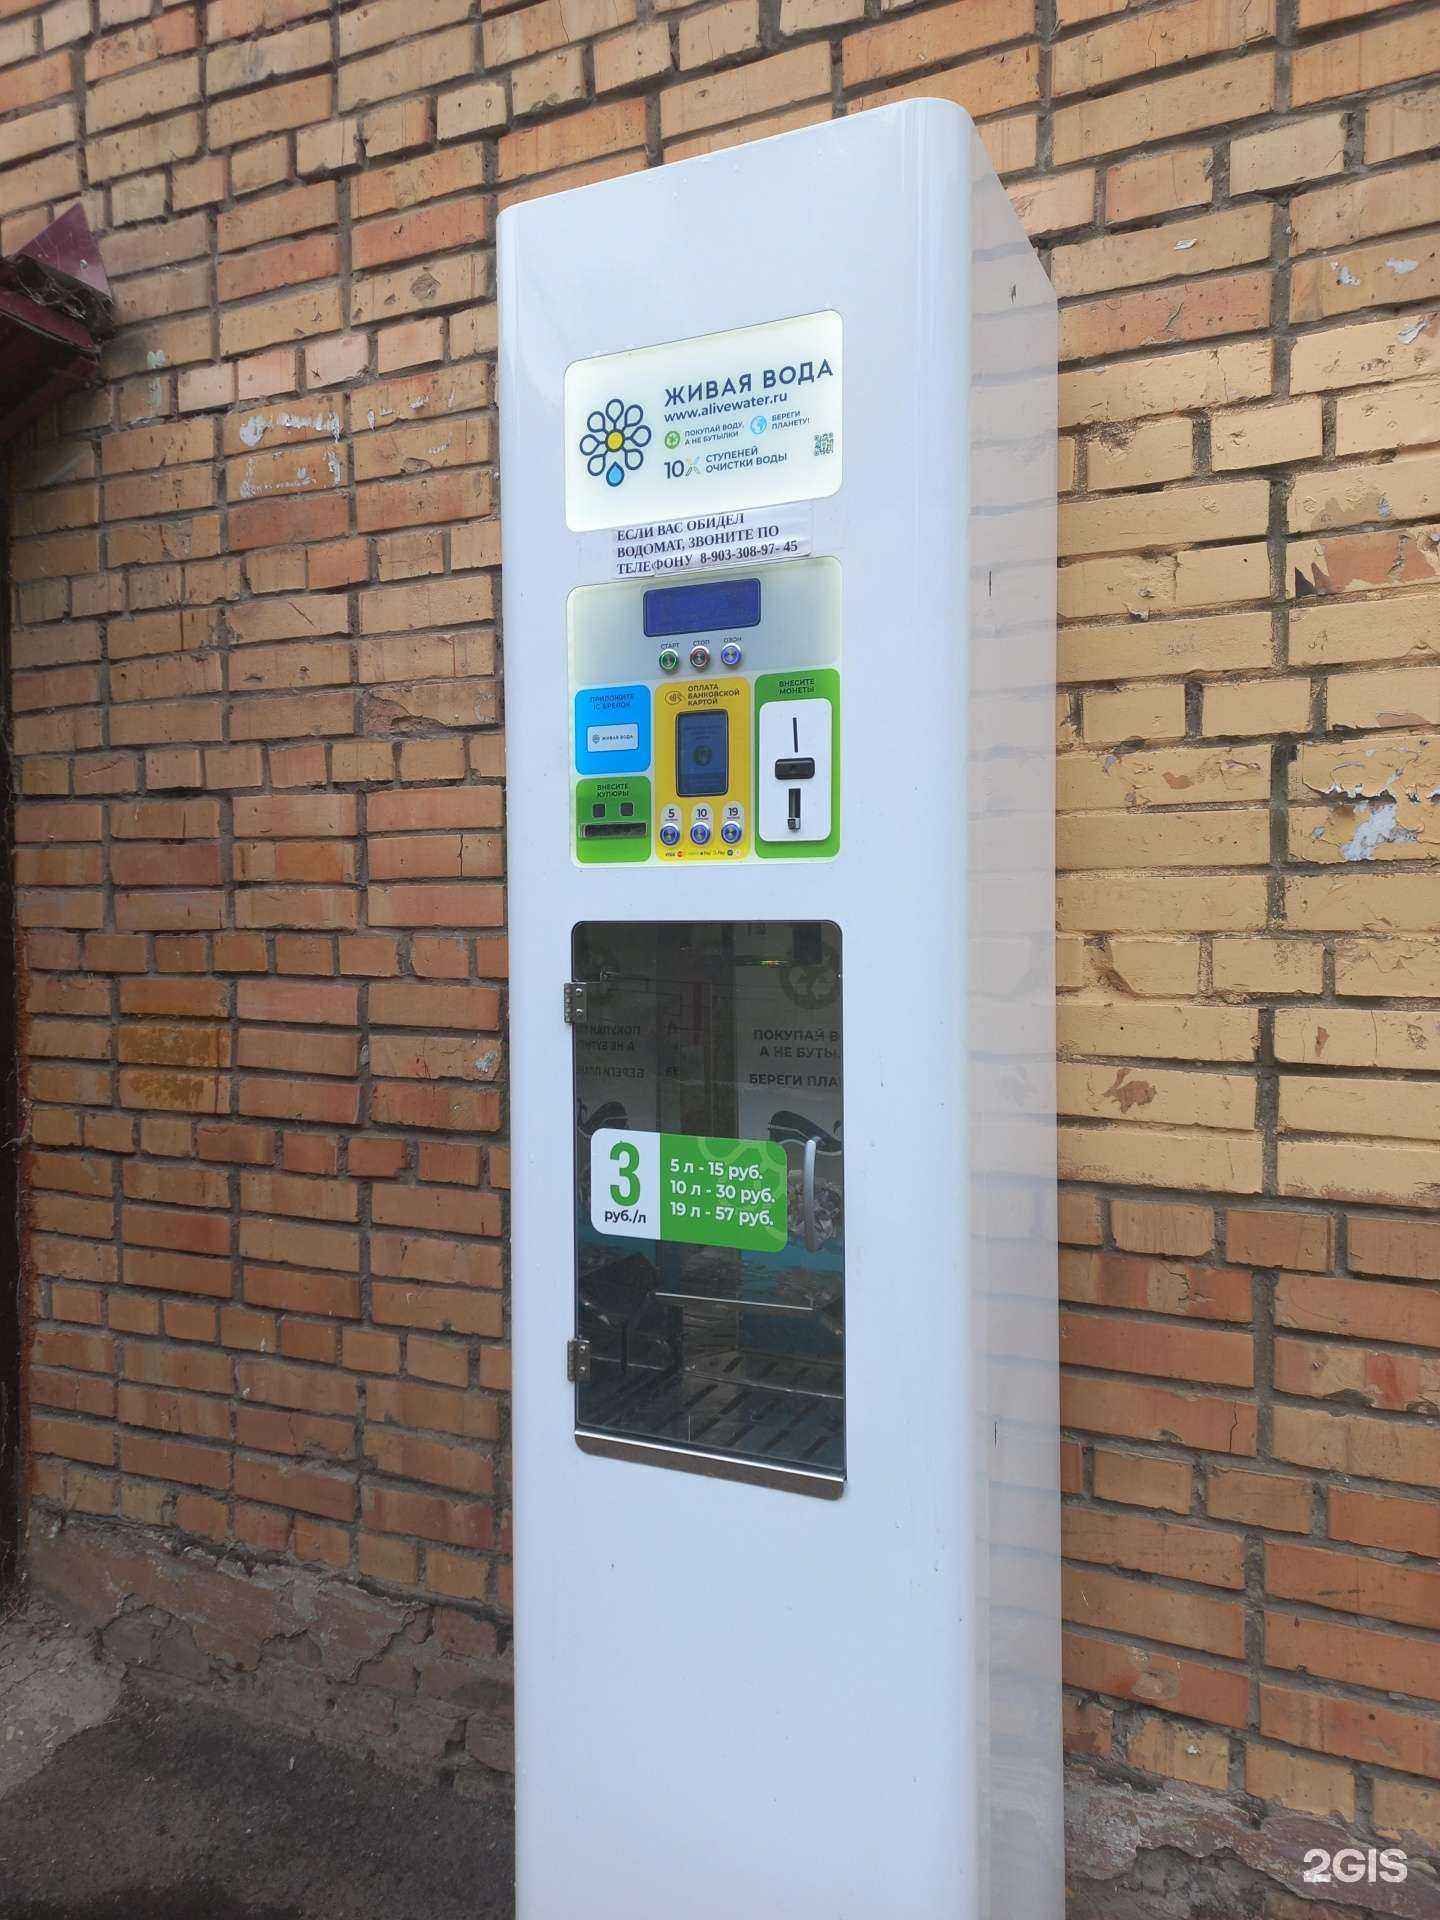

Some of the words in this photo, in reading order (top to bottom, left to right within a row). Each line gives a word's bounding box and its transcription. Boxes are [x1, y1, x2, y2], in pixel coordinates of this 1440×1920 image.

[664, 373, 752, 407] ЖИВАЯ
[763, 359, 834, 389] ВОДА
[664, 391, 788, 423] www.alivewater.ru
[771, 410, 800, 422] БЕРЕГИ
[685, 424, 720, 437] ПОКУПАЙ
[771, 417, 811, 430] ПЛАНЕТУ!
[692, 437, 702, 445] НЕ
[703, 431, 739, 443] БУТЫЛКИ
[705, 445, 759, 463] СТУПЕНЕЙ
[664, 459, 685, 479] 10
[705, 458, 754, 474] ОЧИСТКИ
[756, 453, 788, 466] ВОДЫ
[617, 526, 654, 541] ЕСЛИ
[657, 522, 683, 536] ВАС
[686, 512, 745, 532] ОБИДЕЛ
[617, 538, 685, 559] ВОДОМАТ,
[688, 528, 754, 549] ЗВОНИТЕ
[757, 525, 779, 539] ПО
[616, 554, 693, 575] ТЕЛЕФОНУ
[783, 540, 798, 552] 45
[688, 683, 719, 692] ОПЛАТА
[779, 678, 815, 688] ВНЕСИТЕ
[688, 688, 740, 700] БАНКОВСКОЙ
[779, 686, 815, 695] МОНЕТЫ
[688, 698, 718, 707] КАРТОЙ
[597, 783, 629, 791] ВНЕСИТЕ
[597, 790, 630, 798] КУПЮРЫ
[668, 808, 675, 818] 5
[696, 808, 707, 818] 10
[728, 807, 739, 817] 19
[753, 1027, 825, 1042] ПОКУПАЙ
[760, 1046, 770, 1057] А
[774, 1046, 793, 1058] НЕ
[749, 1073, 803, 1086] БЕРЕГИ
[807, 1075, 841, 1088] ПЛА
[610, 1141, 640, 1207] 3
[670, 1158, 680, 1173] 5
[683, 1162, 694, 1173] л
[708, 1161, 724, 1176] 15
[728, 1164, 763, 1181] руб.
[670, 1180, 687, 1194] 10
[690, 1184, 701, 1196] л
[716, 1184, 736, 1199] 30
[741, 1187, 775, 1204] руб.
[604, 1209, 647, 1224] руб./л
[670, 1201, 686, 1216] 19
[690, 1206, 701, 1218] л
[715, 1206, 735, 1221] 57
[739, 1210, 774, 1227] руб.
